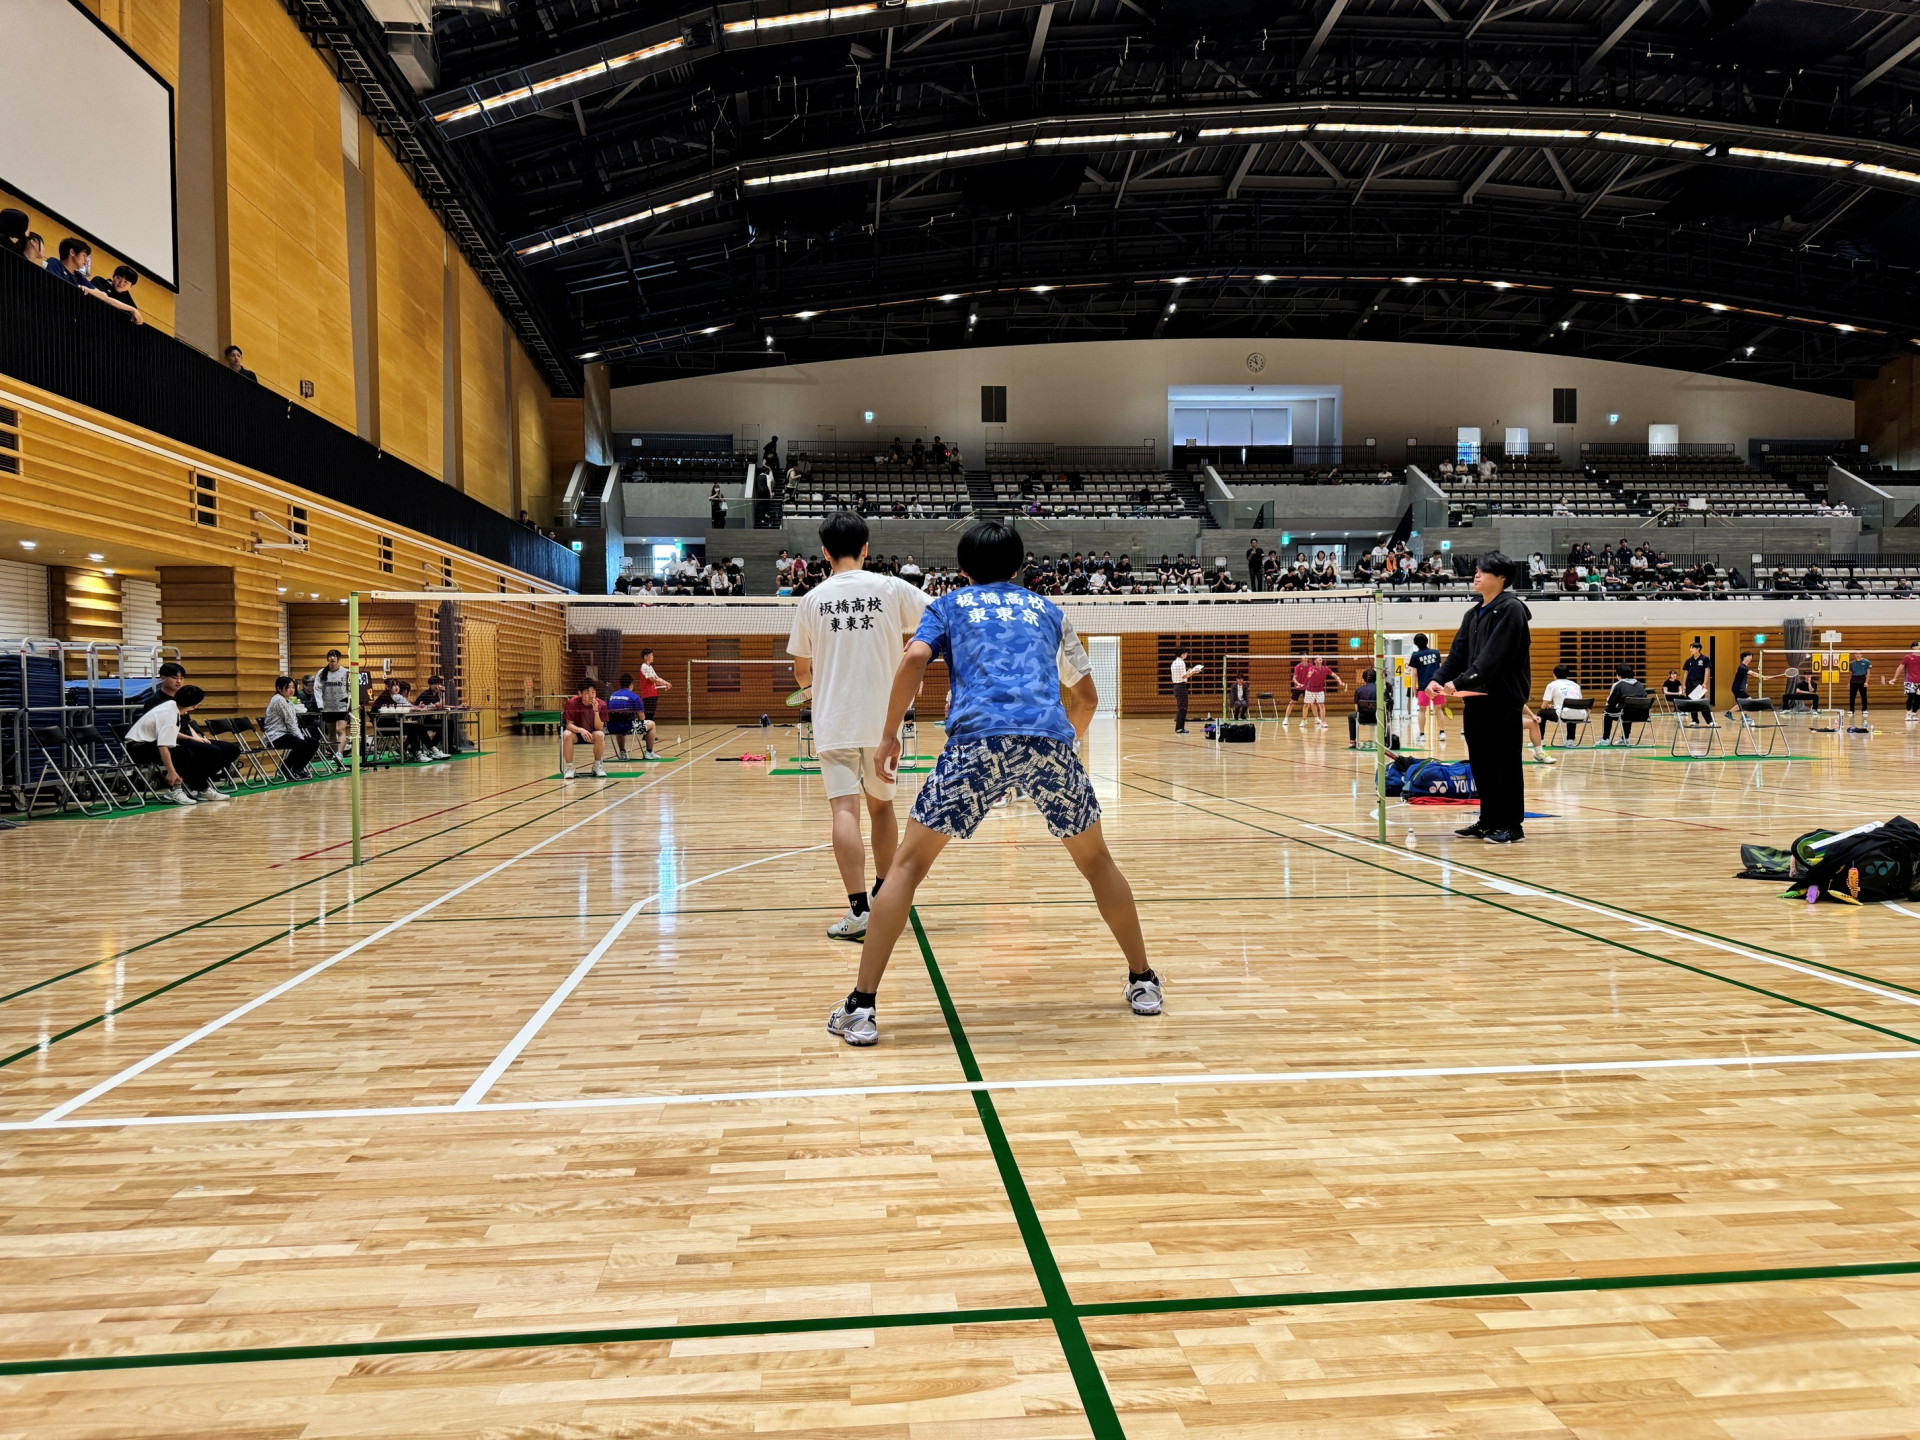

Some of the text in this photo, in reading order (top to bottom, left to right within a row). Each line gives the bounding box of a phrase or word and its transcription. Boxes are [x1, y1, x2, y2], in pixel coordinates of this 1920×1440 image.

[819, 597, 883, 616] 板橋高校
[956, 592, 1046, 613] 板橋高校
[829, 614, 874, 633] 東東京
[968, 606, 1039, 627] 東東京
[1395, 665, 1402, 676] 4
[1813, 661, 1820, 671] 0
[1841, 660, 1848, 671] 0
